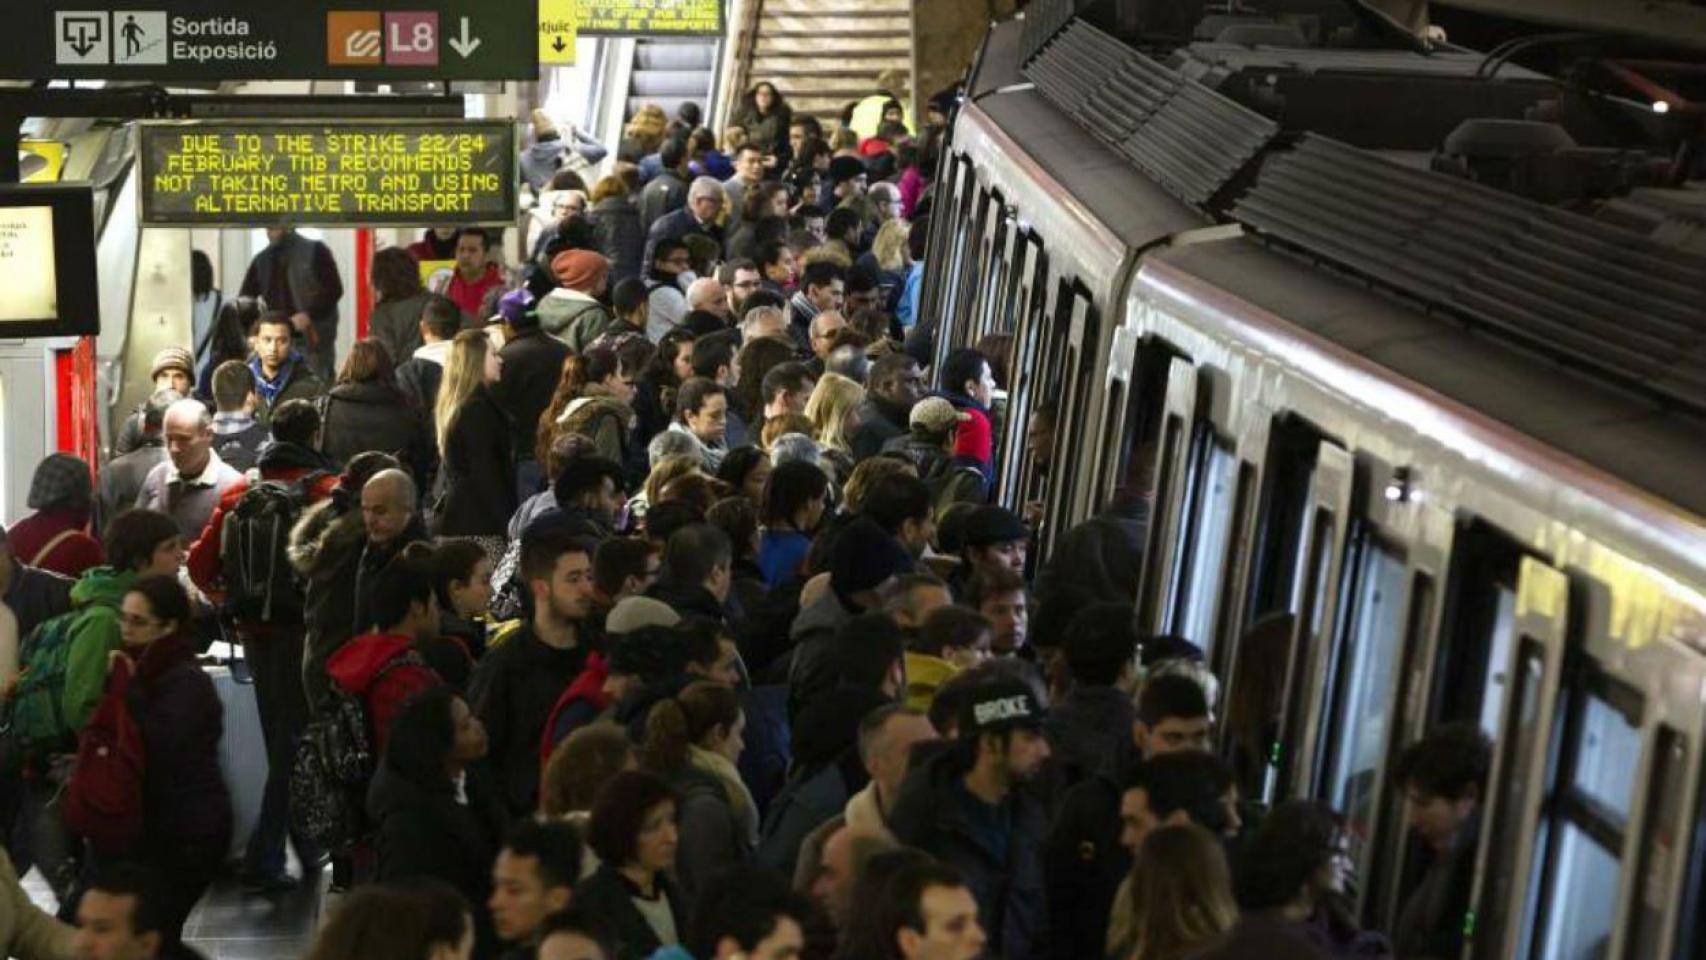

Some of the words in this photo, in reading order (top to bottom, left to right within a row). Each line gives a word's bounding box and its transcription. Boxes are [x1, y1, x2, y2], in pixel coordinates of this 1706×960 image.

[172, 16, 249, 35] Sortida
[391, 22, 434, 51] L8
[172, 40, 278, 63] Exposició
[181, 135, 224, 153] DUE
[235, 135, 263, 153] TO
[276, 135, 314, 153] THE
[326, 135, 406, 153] STRIKE
[416, 135, 487, 153] 22/24
[166, 154, 274, 172] FEBRUARY
[290, 154, 328, 172] TMB
[340, 154, 472, 172] RECOMMENDS
[155, 174, 196, 192] NOT
[208, 174, 288, 192] TAKING
[298, 174, 370, 192] METRO
[379, 174, 423, 192] AND
[432, 174, 499, 192] USING
[195, 193, 342, 212] ALTERNATIVE
[354, 193, 473, 212] TRANSPORT
